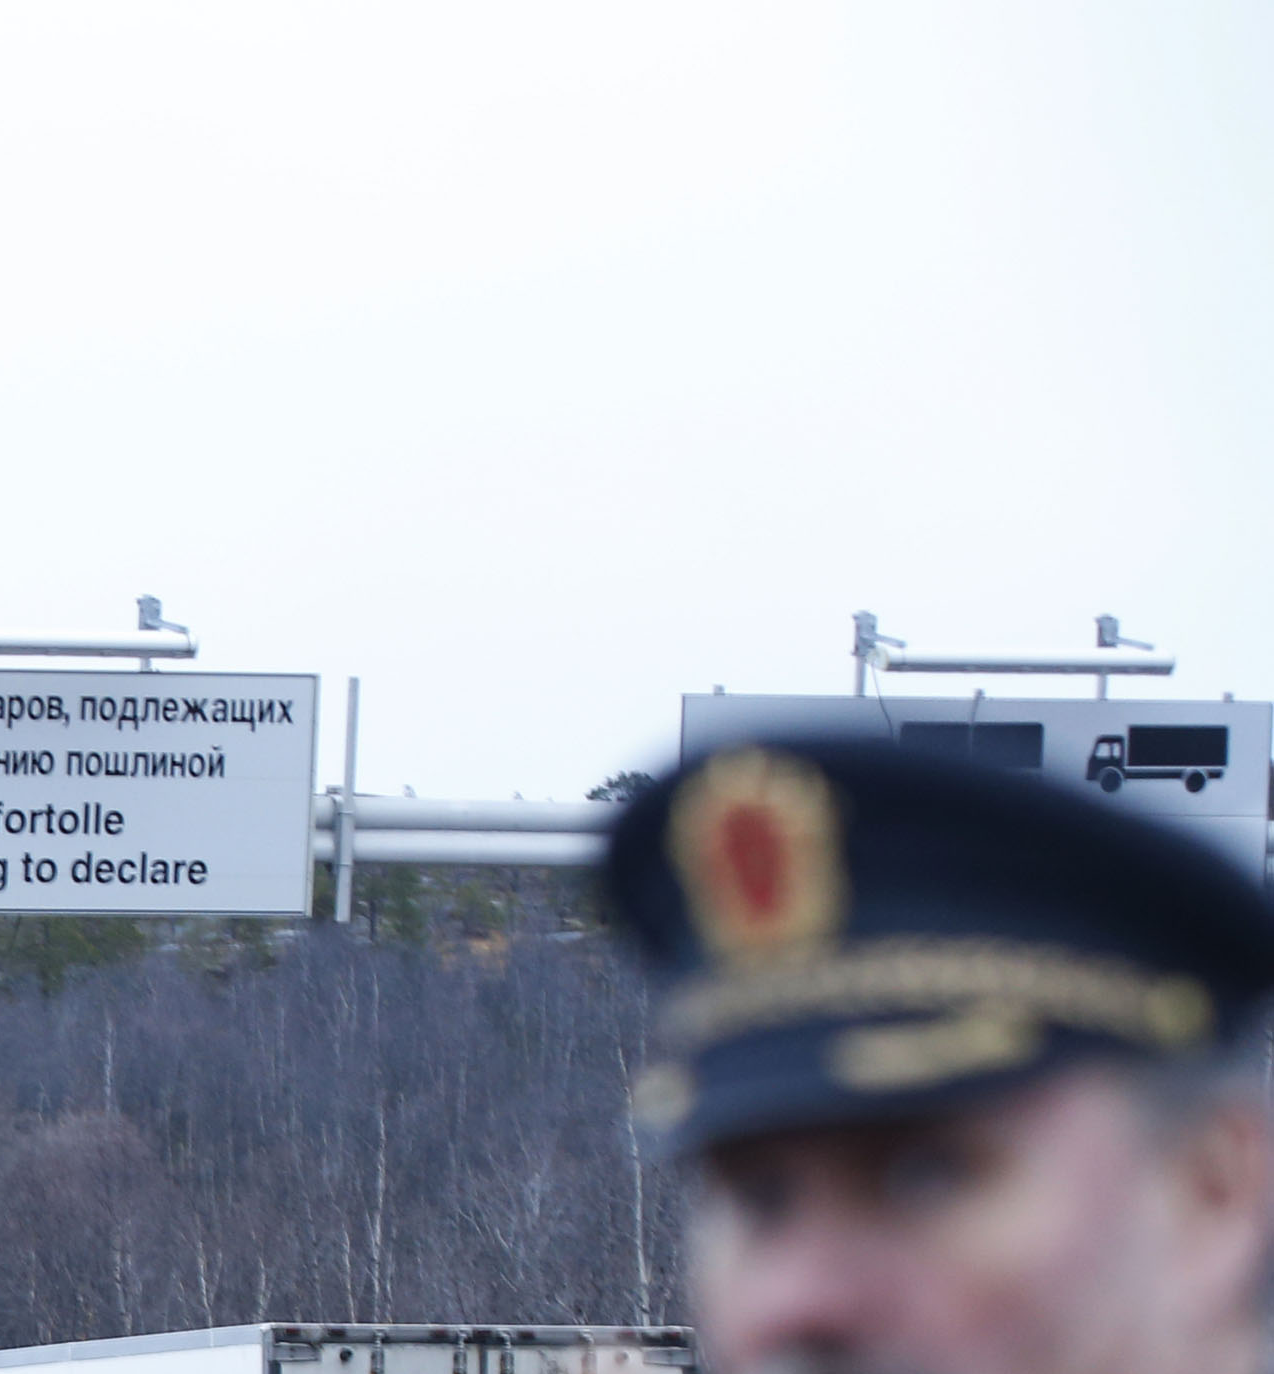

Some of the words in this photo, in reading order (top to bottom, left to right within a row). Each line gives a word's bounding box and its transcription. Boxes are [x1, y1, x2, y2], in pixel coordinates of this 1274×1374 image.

[80, 695, 294, 732] подлежащих
[66, 745, 226, 778] пошлиной
[21, 852, 58, 884] to
[70, 851, 209, 885] declare
